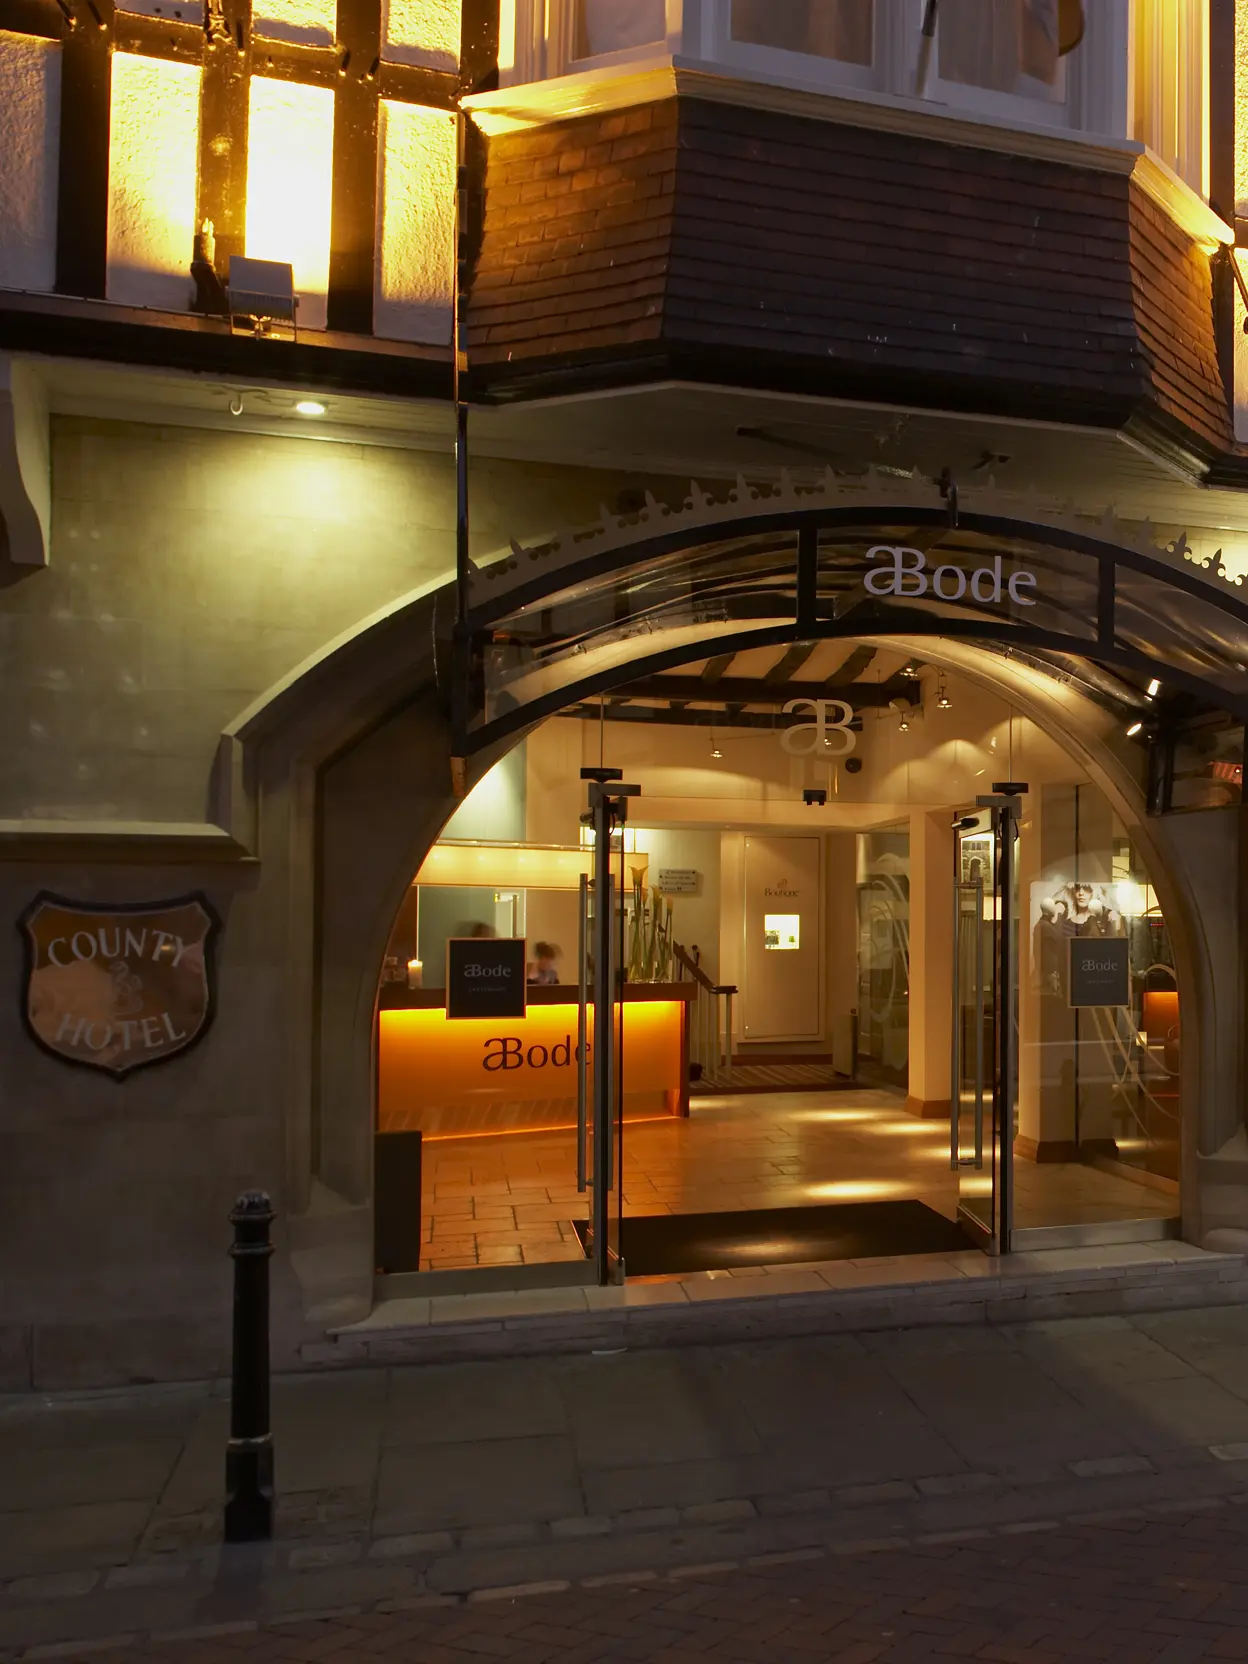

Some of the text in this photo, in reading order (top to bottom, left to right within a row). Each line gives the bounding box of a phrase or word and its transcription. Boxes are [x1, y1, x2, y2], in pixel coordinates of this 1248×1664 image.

[863, 545, 1037, 606] aBode
[48, 927, 195, 968] COUNTY
[55, 1012, 186, 1050] HOTEL
